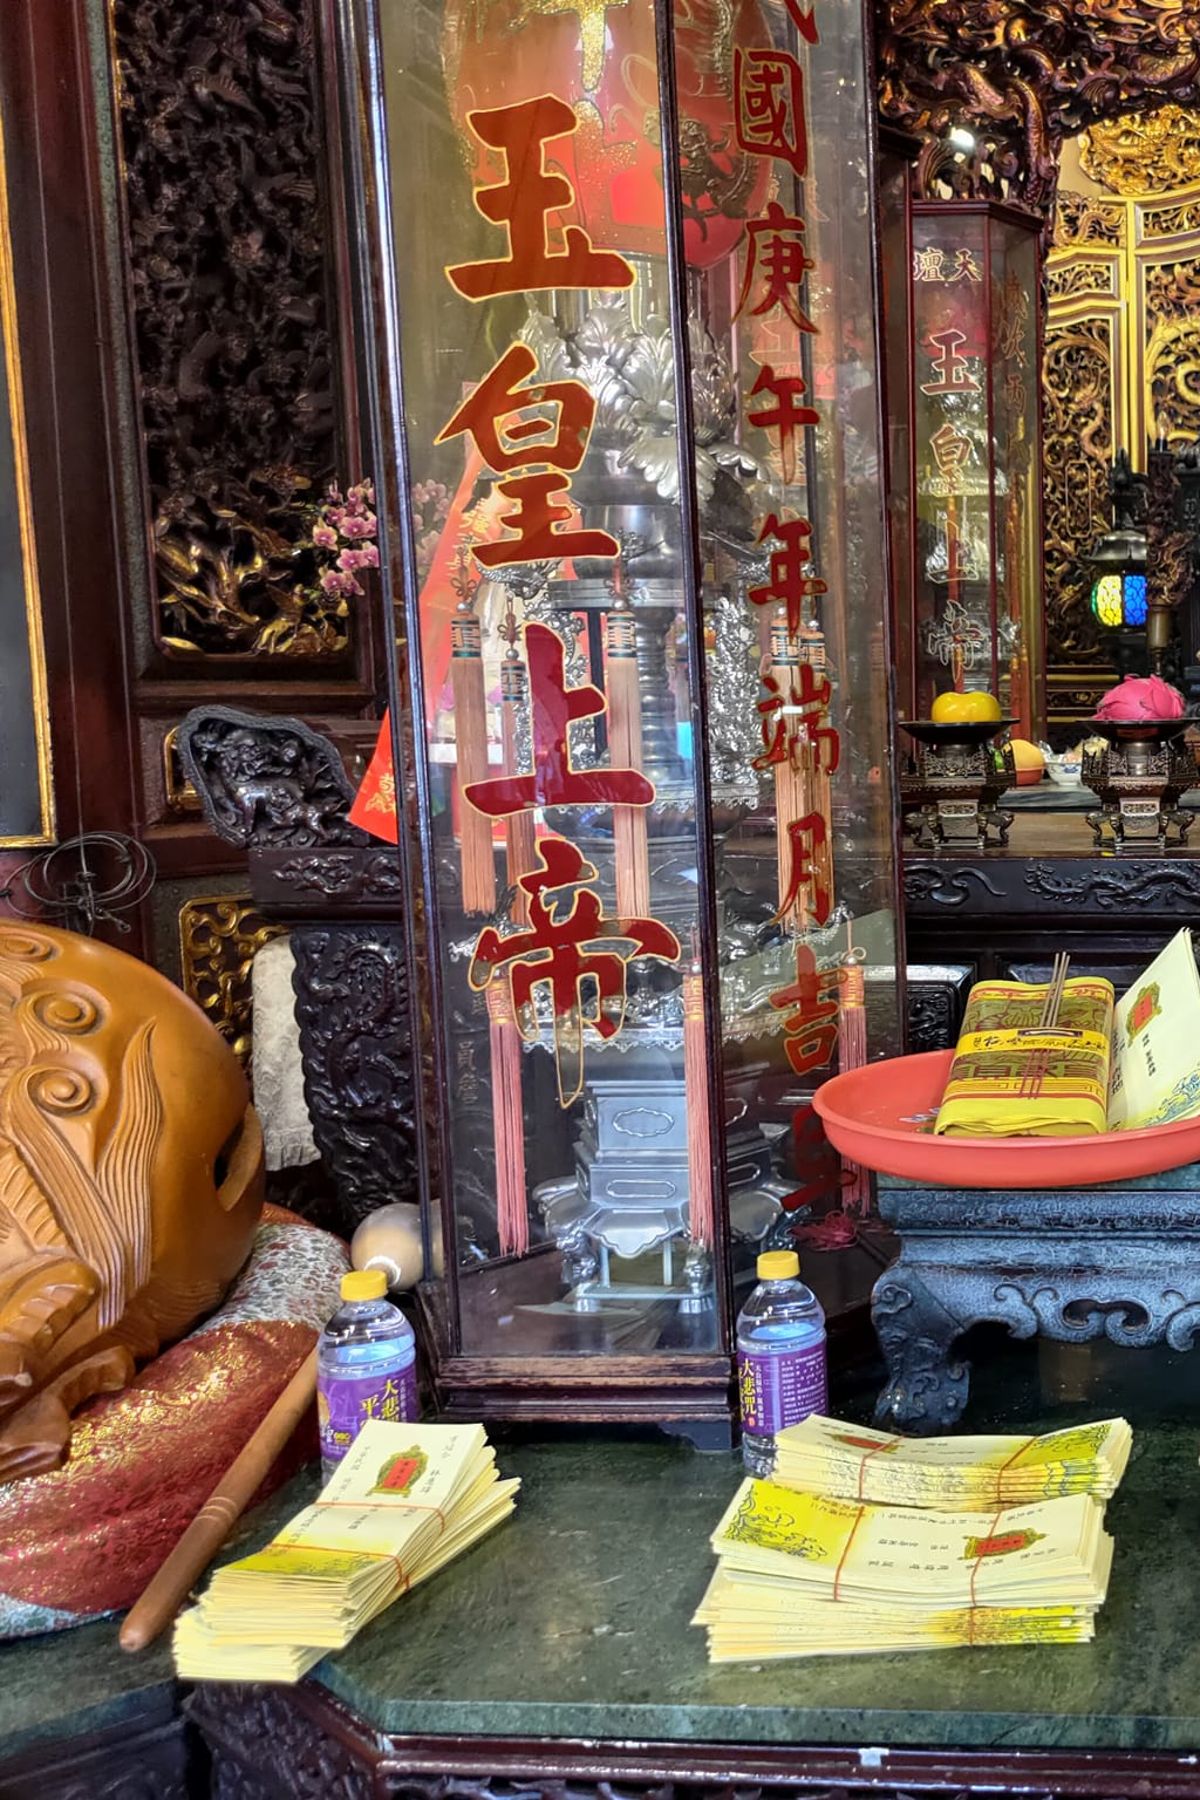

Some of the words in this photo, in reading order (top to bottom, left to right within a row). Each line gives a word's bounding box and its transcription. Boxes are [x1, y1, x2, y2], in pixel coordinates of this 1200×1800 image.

[434, 94, 682, 1110] 玉皇上帝
[920, 328, 985, 684] 玉皇上帝
[381, 1379, 400, 1422] 大悲
[743, 1358, 757, 1415] 大悲咒
